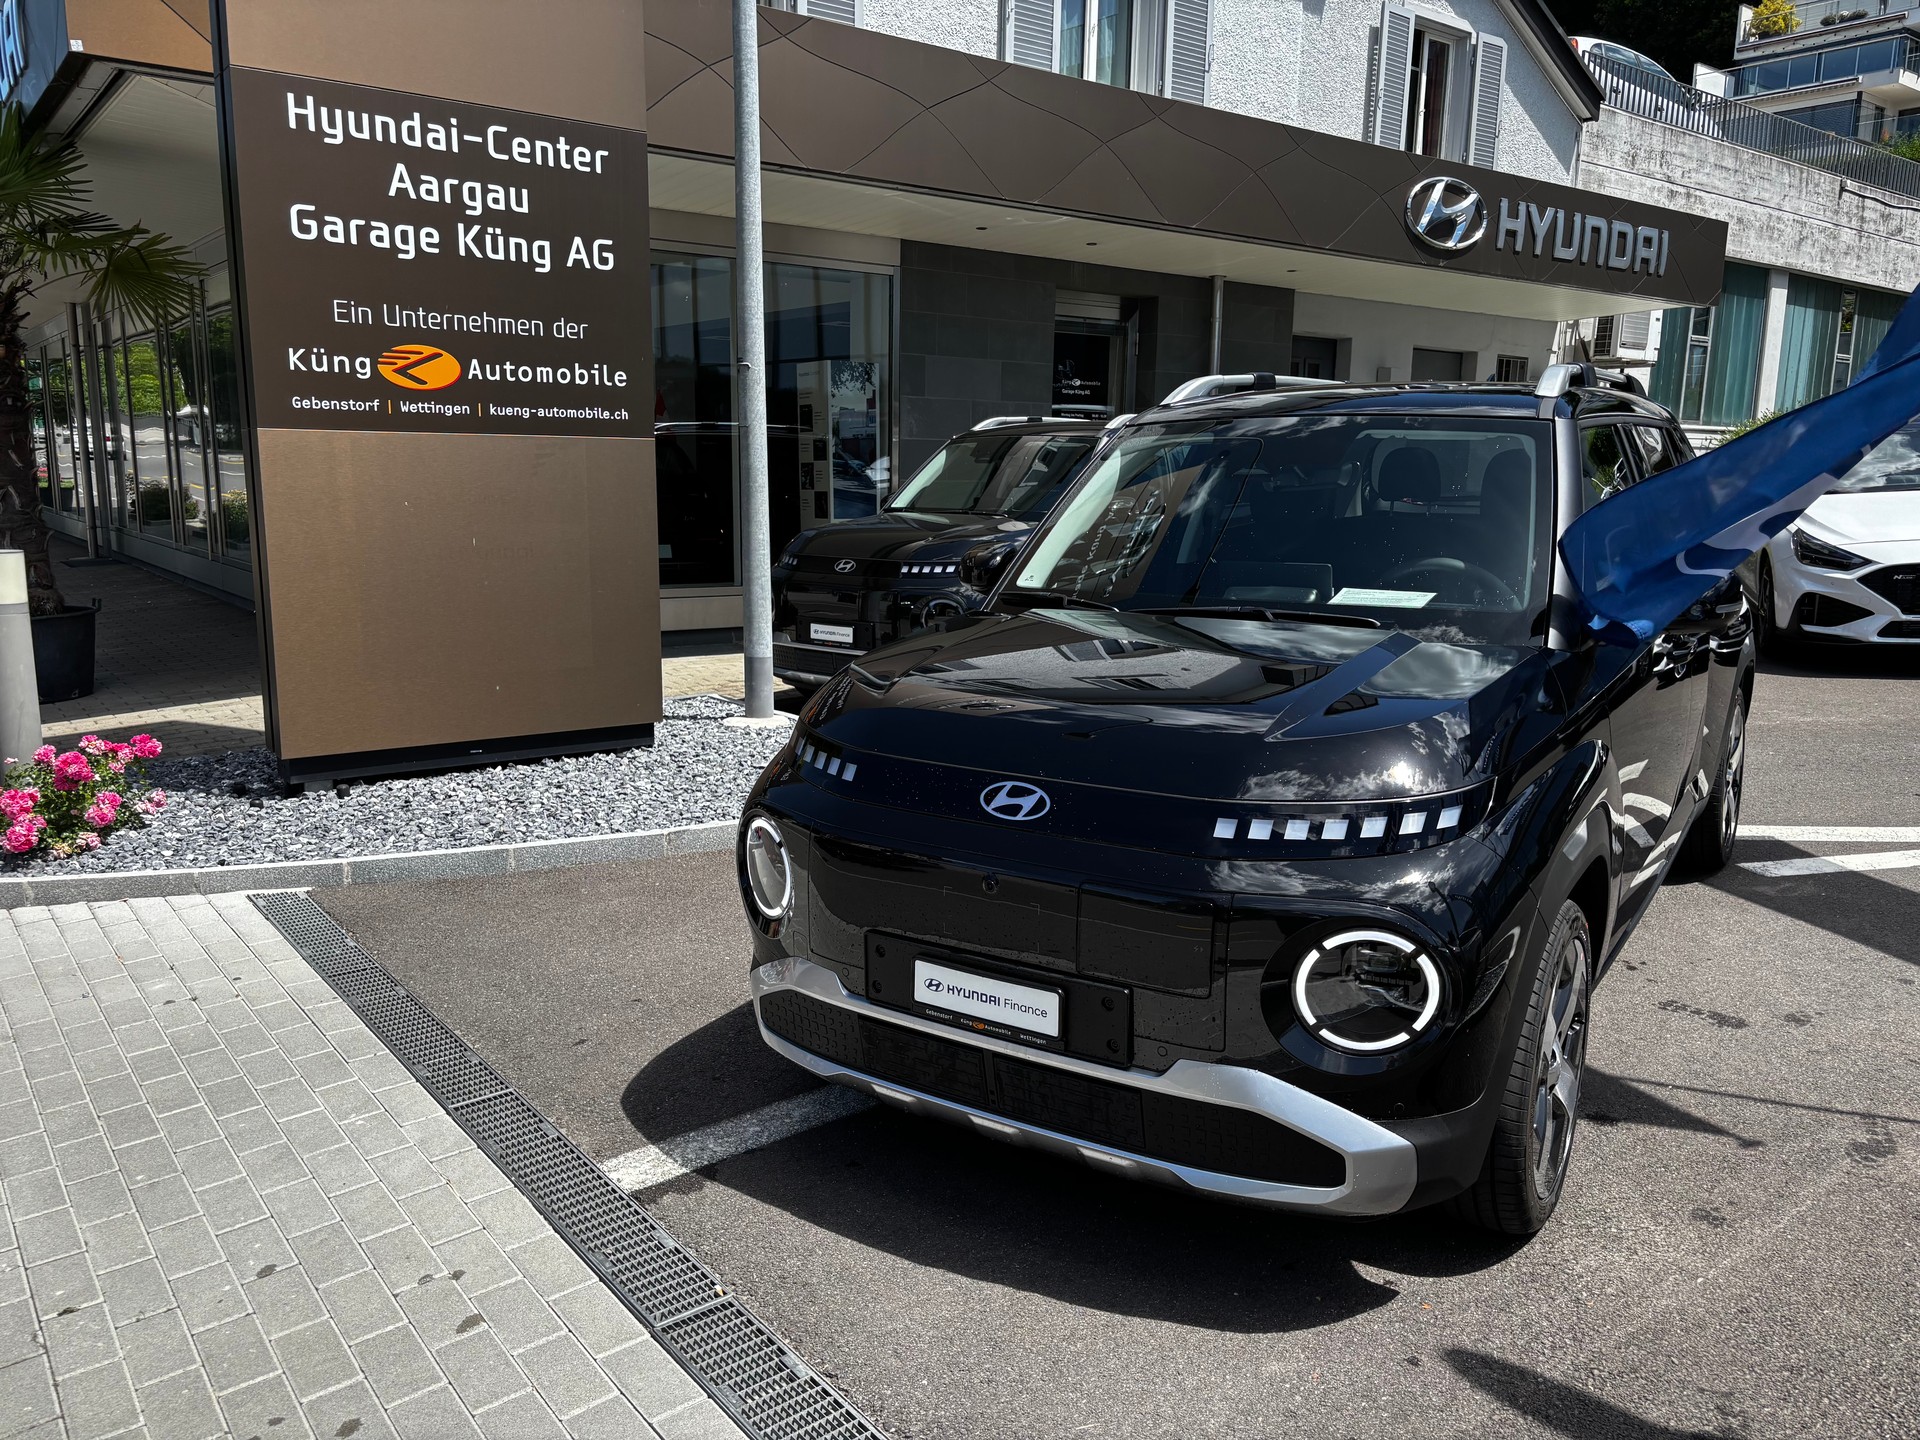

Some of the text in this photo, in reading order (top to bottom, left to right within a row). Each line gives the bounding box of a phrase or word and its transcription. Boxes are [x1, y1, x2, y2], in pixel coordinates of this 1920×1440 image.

[286, 92, 609, 174] Hyundai-Center
[388, 163, 529, 216] Aargau
[290, 204, 615, 273] Garage Küng AG
[1496, 197, 1669, 277] HYUNDAI
[333, 299, 589, 339] Ein Unternehmen der
[288, 347, 628, 387] Küng Automobile
[292, 396, 629, 420] Gebenstorf Wettingen kueng-automobile.ch
[947, 984, 1048, 1018] HYUNDAI Finance
[925, 1008, 1047, 1045] Gebenstorf Küng Automobile Wettingen
